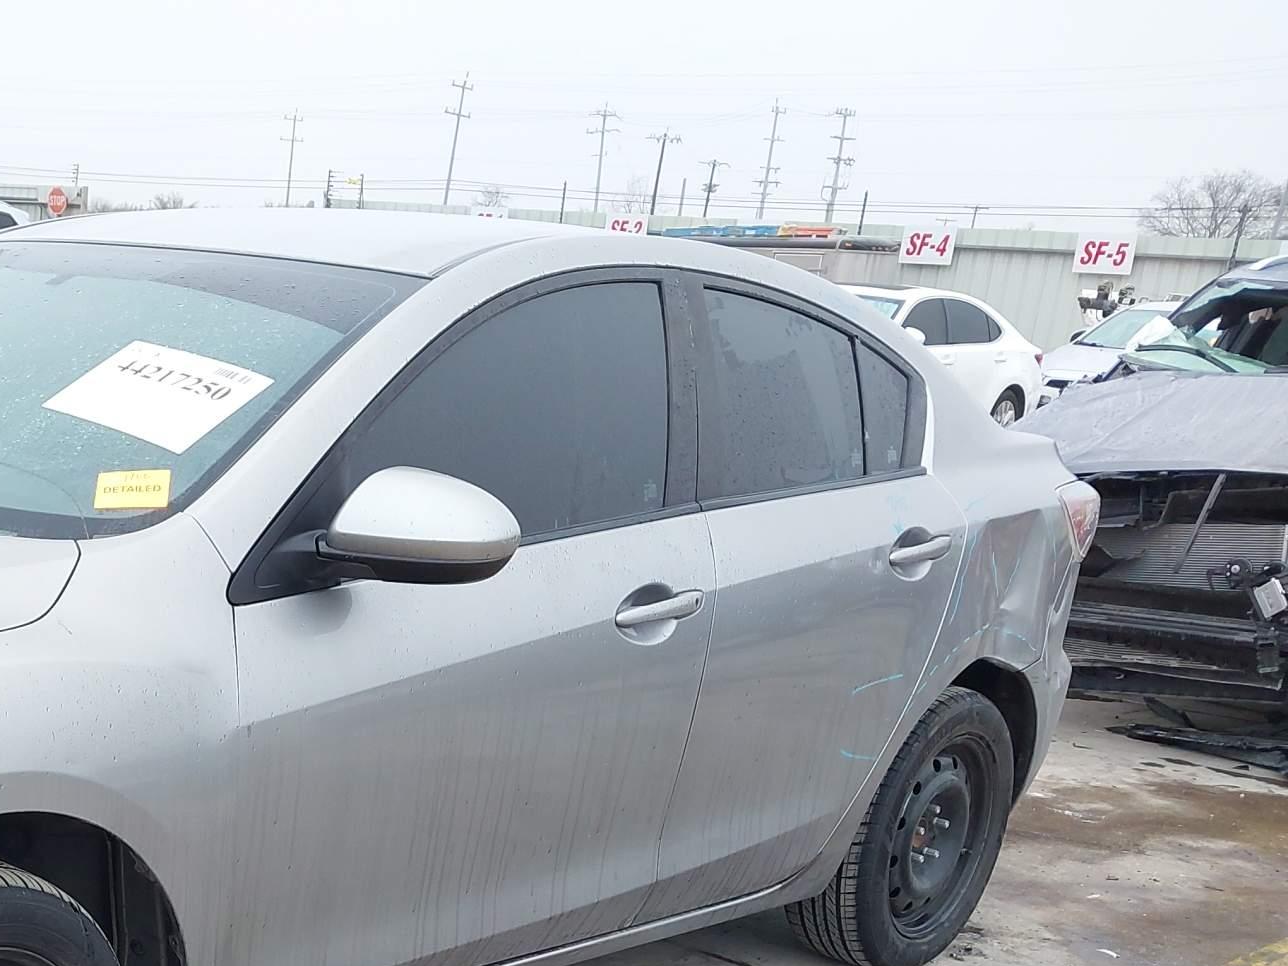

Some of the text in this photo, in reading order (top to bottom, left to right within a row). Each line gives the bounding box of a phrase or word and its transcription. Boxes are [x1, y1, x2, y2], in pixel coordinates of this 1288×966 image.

[49, 195, 66, 206] STOP
[905, 232, 951, 257] SF-4
[1079, 240, 1130, 267] SF-5
[117, 360, 232, 401] 44217250
[103, 484, 162, 494] DETAILED
